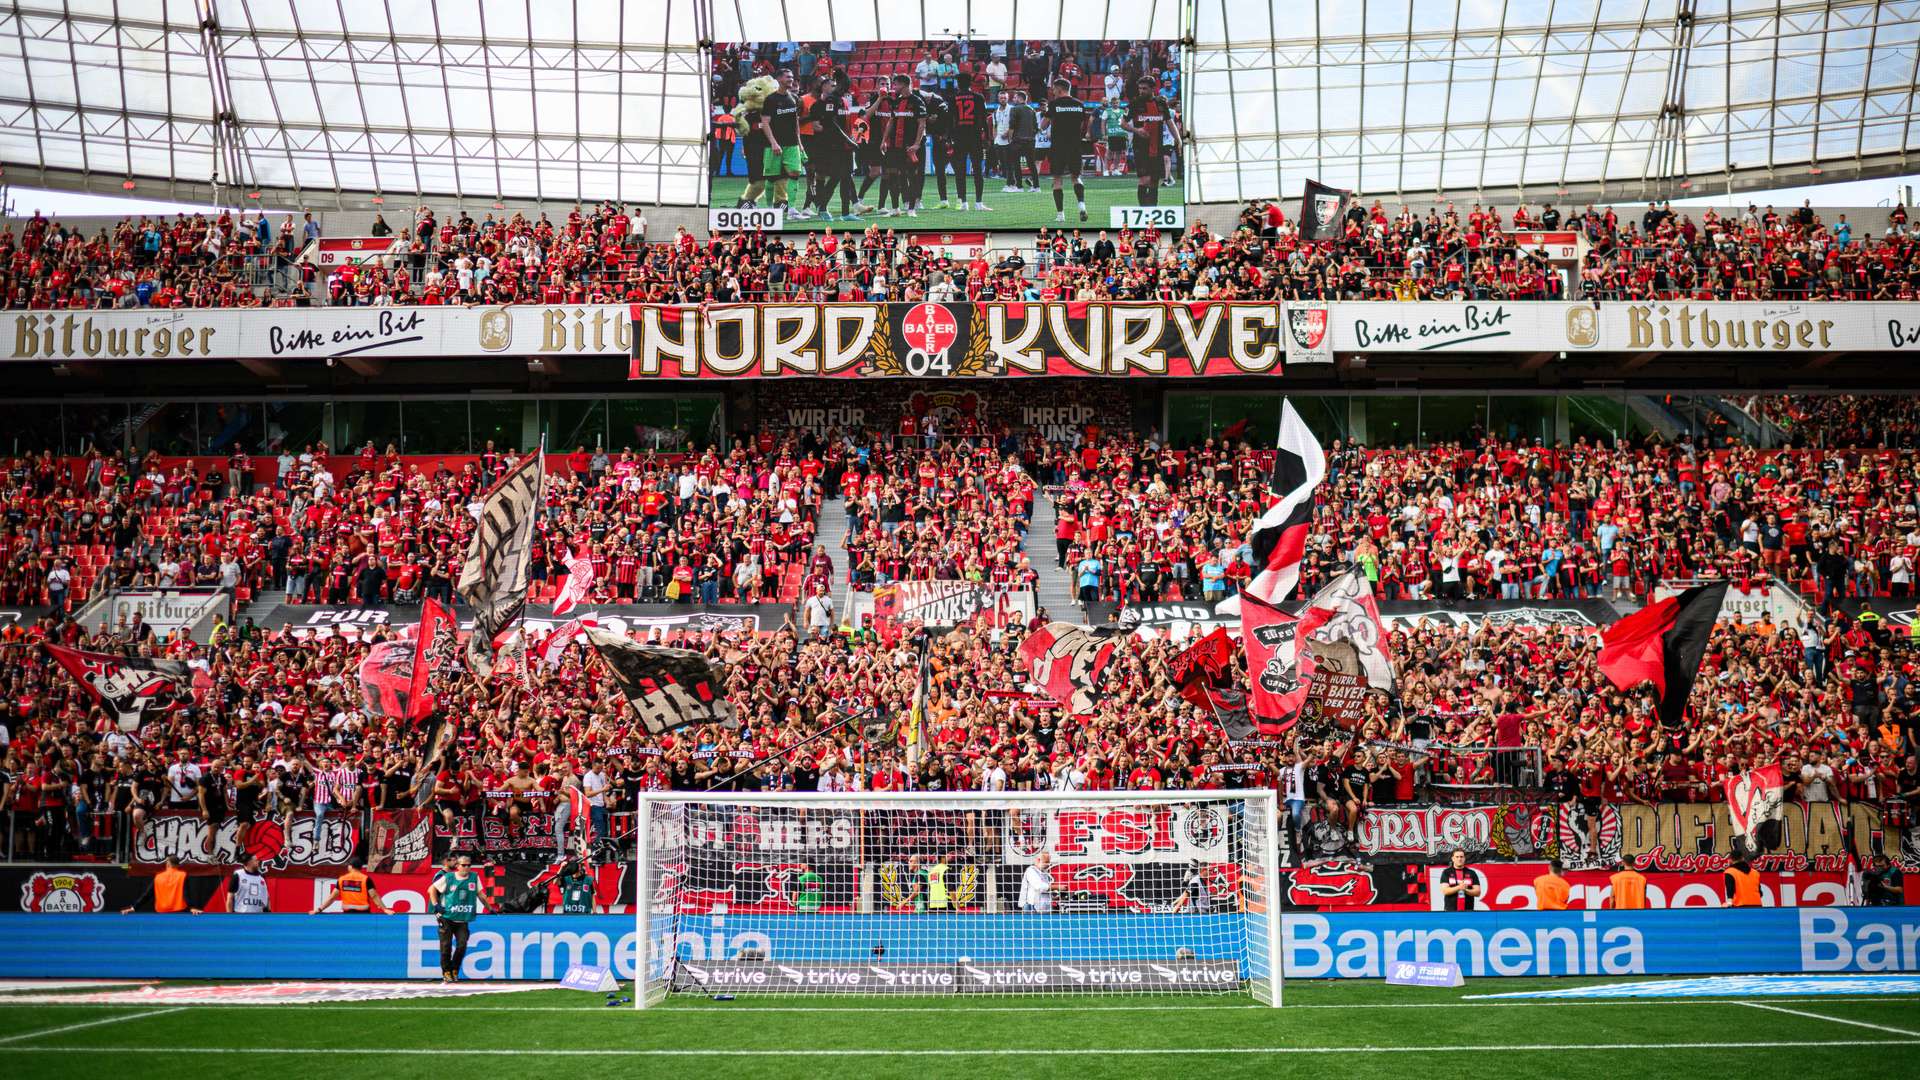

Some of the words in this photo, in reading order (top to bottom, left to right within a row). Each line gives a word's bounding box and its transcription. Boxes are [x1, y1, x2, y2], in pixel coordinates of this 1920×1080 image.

[956, 100, 974, 120] 12
[717, 211, 775, 228] 90:00
[1120, 209, 1177, 227] 17:26
[321, 253, 334, 263] D9
[11, 313, 216, 358] Bitburger
[269, 325, 326, 355] Bitte
[331, 324, 374, 343] ein
[379, 310, 425, 337] Bit
[904, 323, 955, 334] BAYER
[1355, 319, 1412, 348] Bitte
[1418, 319, 1461, 338] ein
[1465, 305, 1511, 331] Bit
[1626, 304, 1835, 350] Bitburger
[987, 302, 1280, 373] KURVE
[906, 347, 951, 376] 04
[787, 408, 826, 426] WIR
[827, 404, 865, 426] FÜR
[1023, 407, 1056, 425] IHR
[1057, 404, 1095, 425] FÜR
[1328, 684, 1366, 700] BAYER
[1324, 698, 1345, 708] DER
[1346, 700, 1362, 710] IST
[759, 819, 852, 850] HERS
[1055, 810, 1179, 858] FSI
[46, 903, 79, 911] BAYER
[1281, 911, 1646, 979] Barmenia
[713, 968, 767, 984] trive
[807, 968, 861, 985] trive
[899, 969, 953, 985] trive
[993, 968, 1048, 984] trive
[1089, 966, 1142, 983] trive
[1181, 965, 1235, 982] trive
